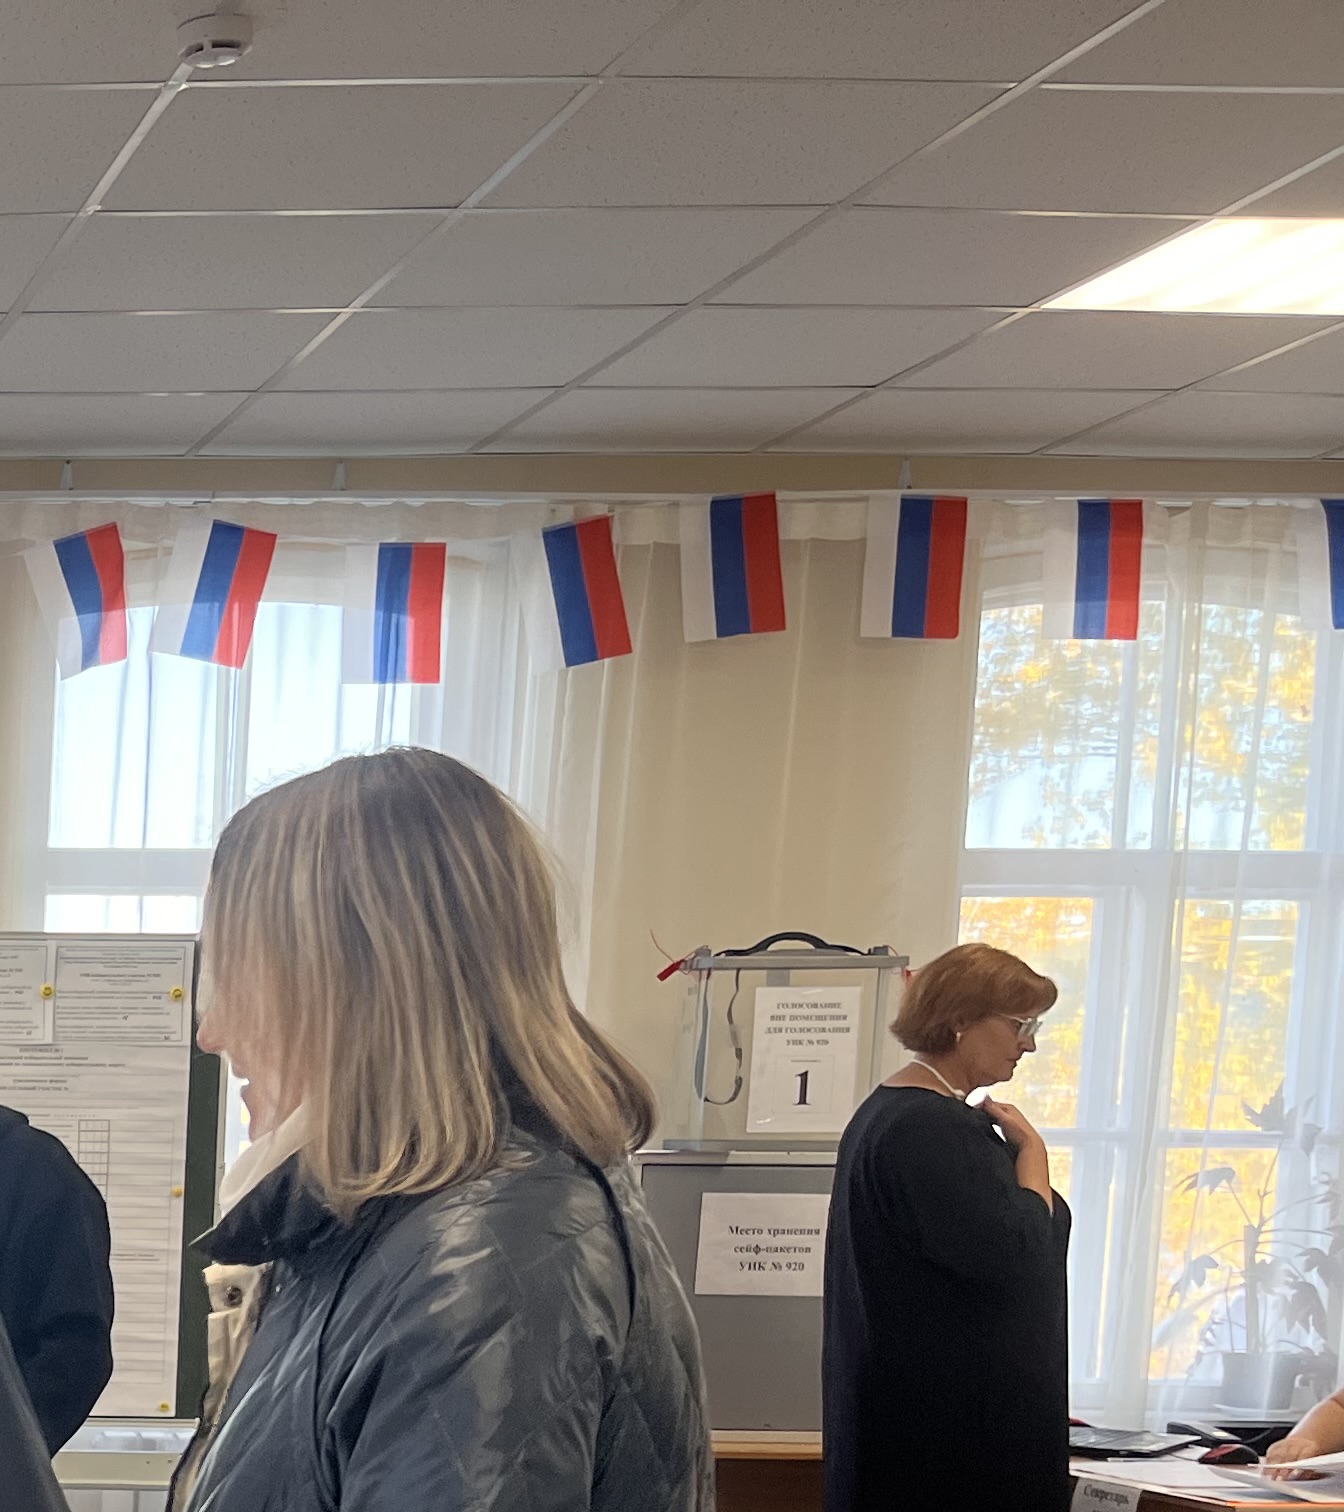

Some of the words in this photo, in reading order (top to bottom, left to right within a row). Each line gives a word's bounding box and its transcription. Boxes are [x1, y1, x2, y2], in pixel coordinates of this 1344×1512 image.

[794, 1069, 812, 1106] 1
[728, 1225, 763, 1235] Место
[767, 1227, 820, 1237] хранения
[733, 1244, 812, 1255] сейф-пакетов
[739, 1261, 767, 1271] УИК
[769, 1261, 783, 1271] №
[785, 1261, 805, 1271] 920
